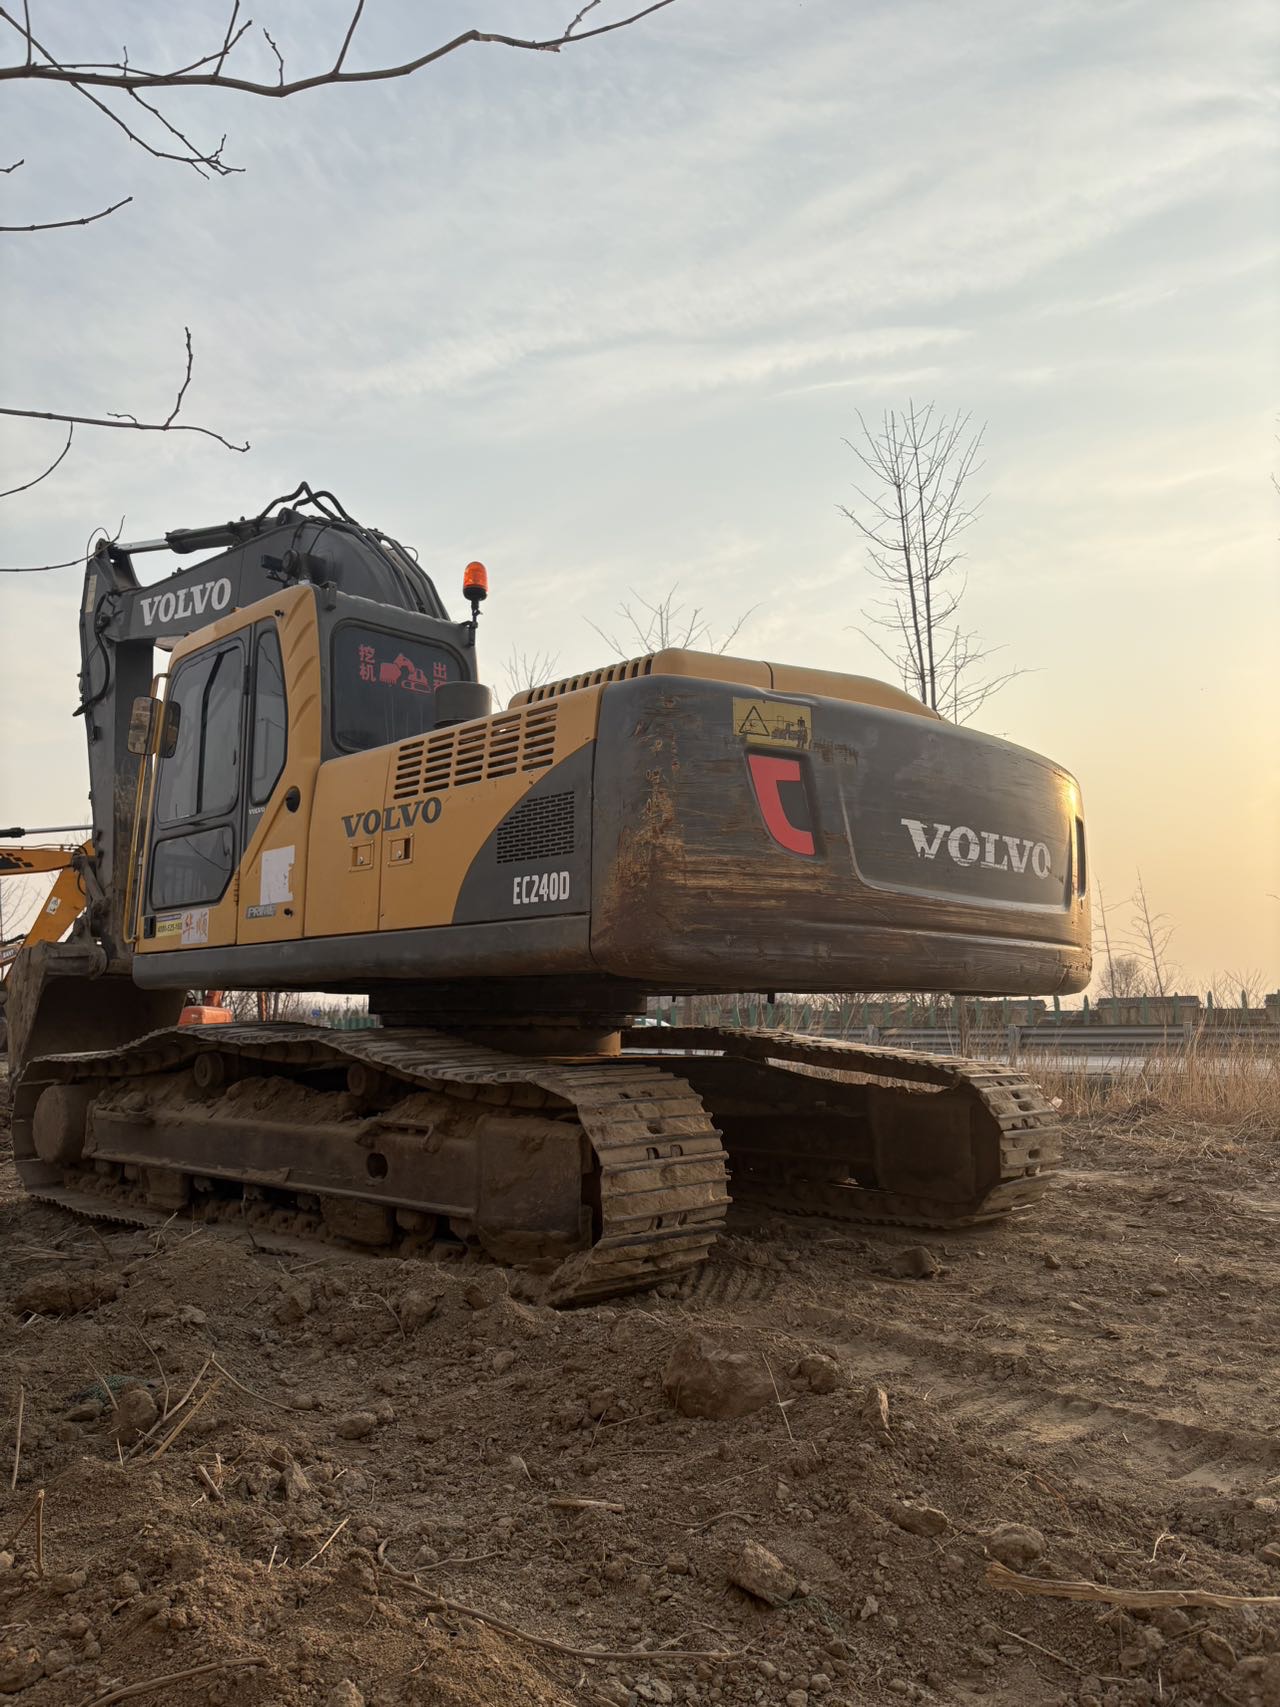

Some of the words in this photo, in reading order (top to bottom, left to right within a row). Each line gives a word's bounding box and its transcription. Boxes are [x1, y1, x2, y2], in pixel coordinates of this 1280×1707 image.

[140, 578, 232, 626] VOLVO
[358, 644, 376, 682] 挖机
[341, 797, 442, 838] VOLVO
[901, 818, 1051, 880] VOLVO
[513, 871, 570, 905] EC240D
